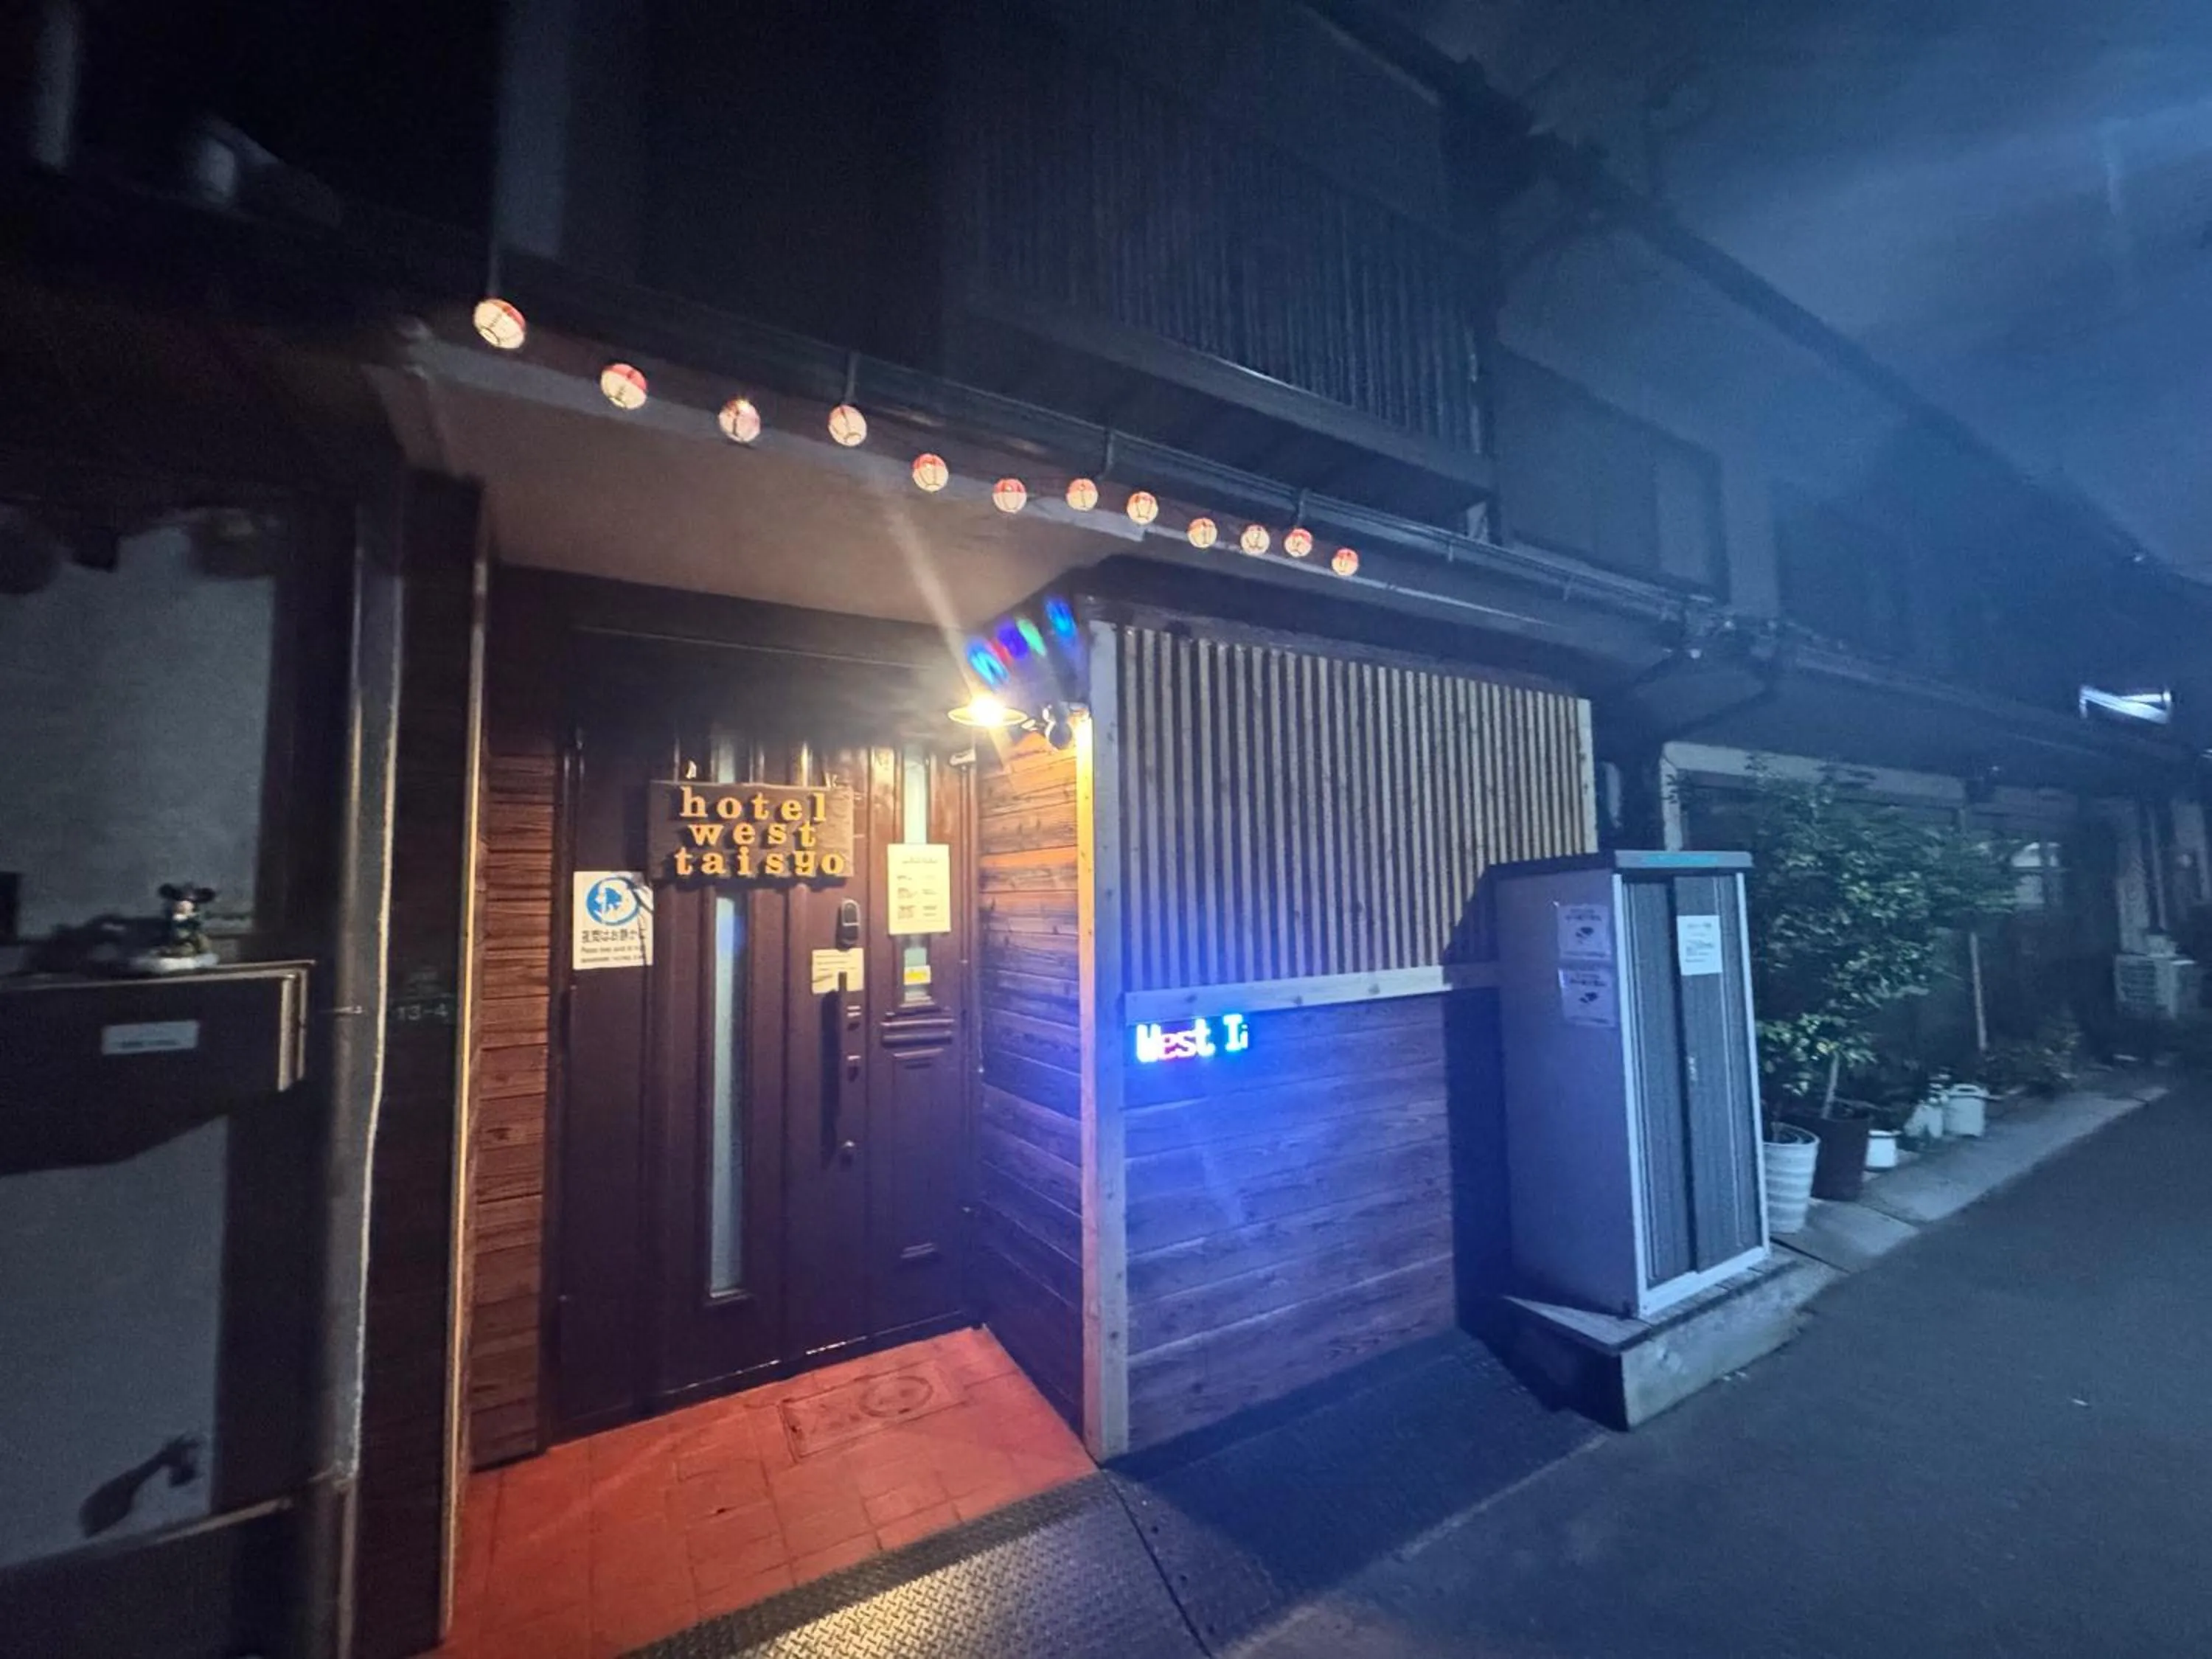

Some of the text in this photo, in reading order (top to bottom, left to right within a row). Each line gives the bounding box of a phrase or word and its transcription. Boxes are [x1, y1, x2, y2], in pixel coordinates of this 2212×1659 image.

[680, 786, 826, 821] hotel
[687, 820, 816, 847] west
[675, 846, 845, 877] taisyo
